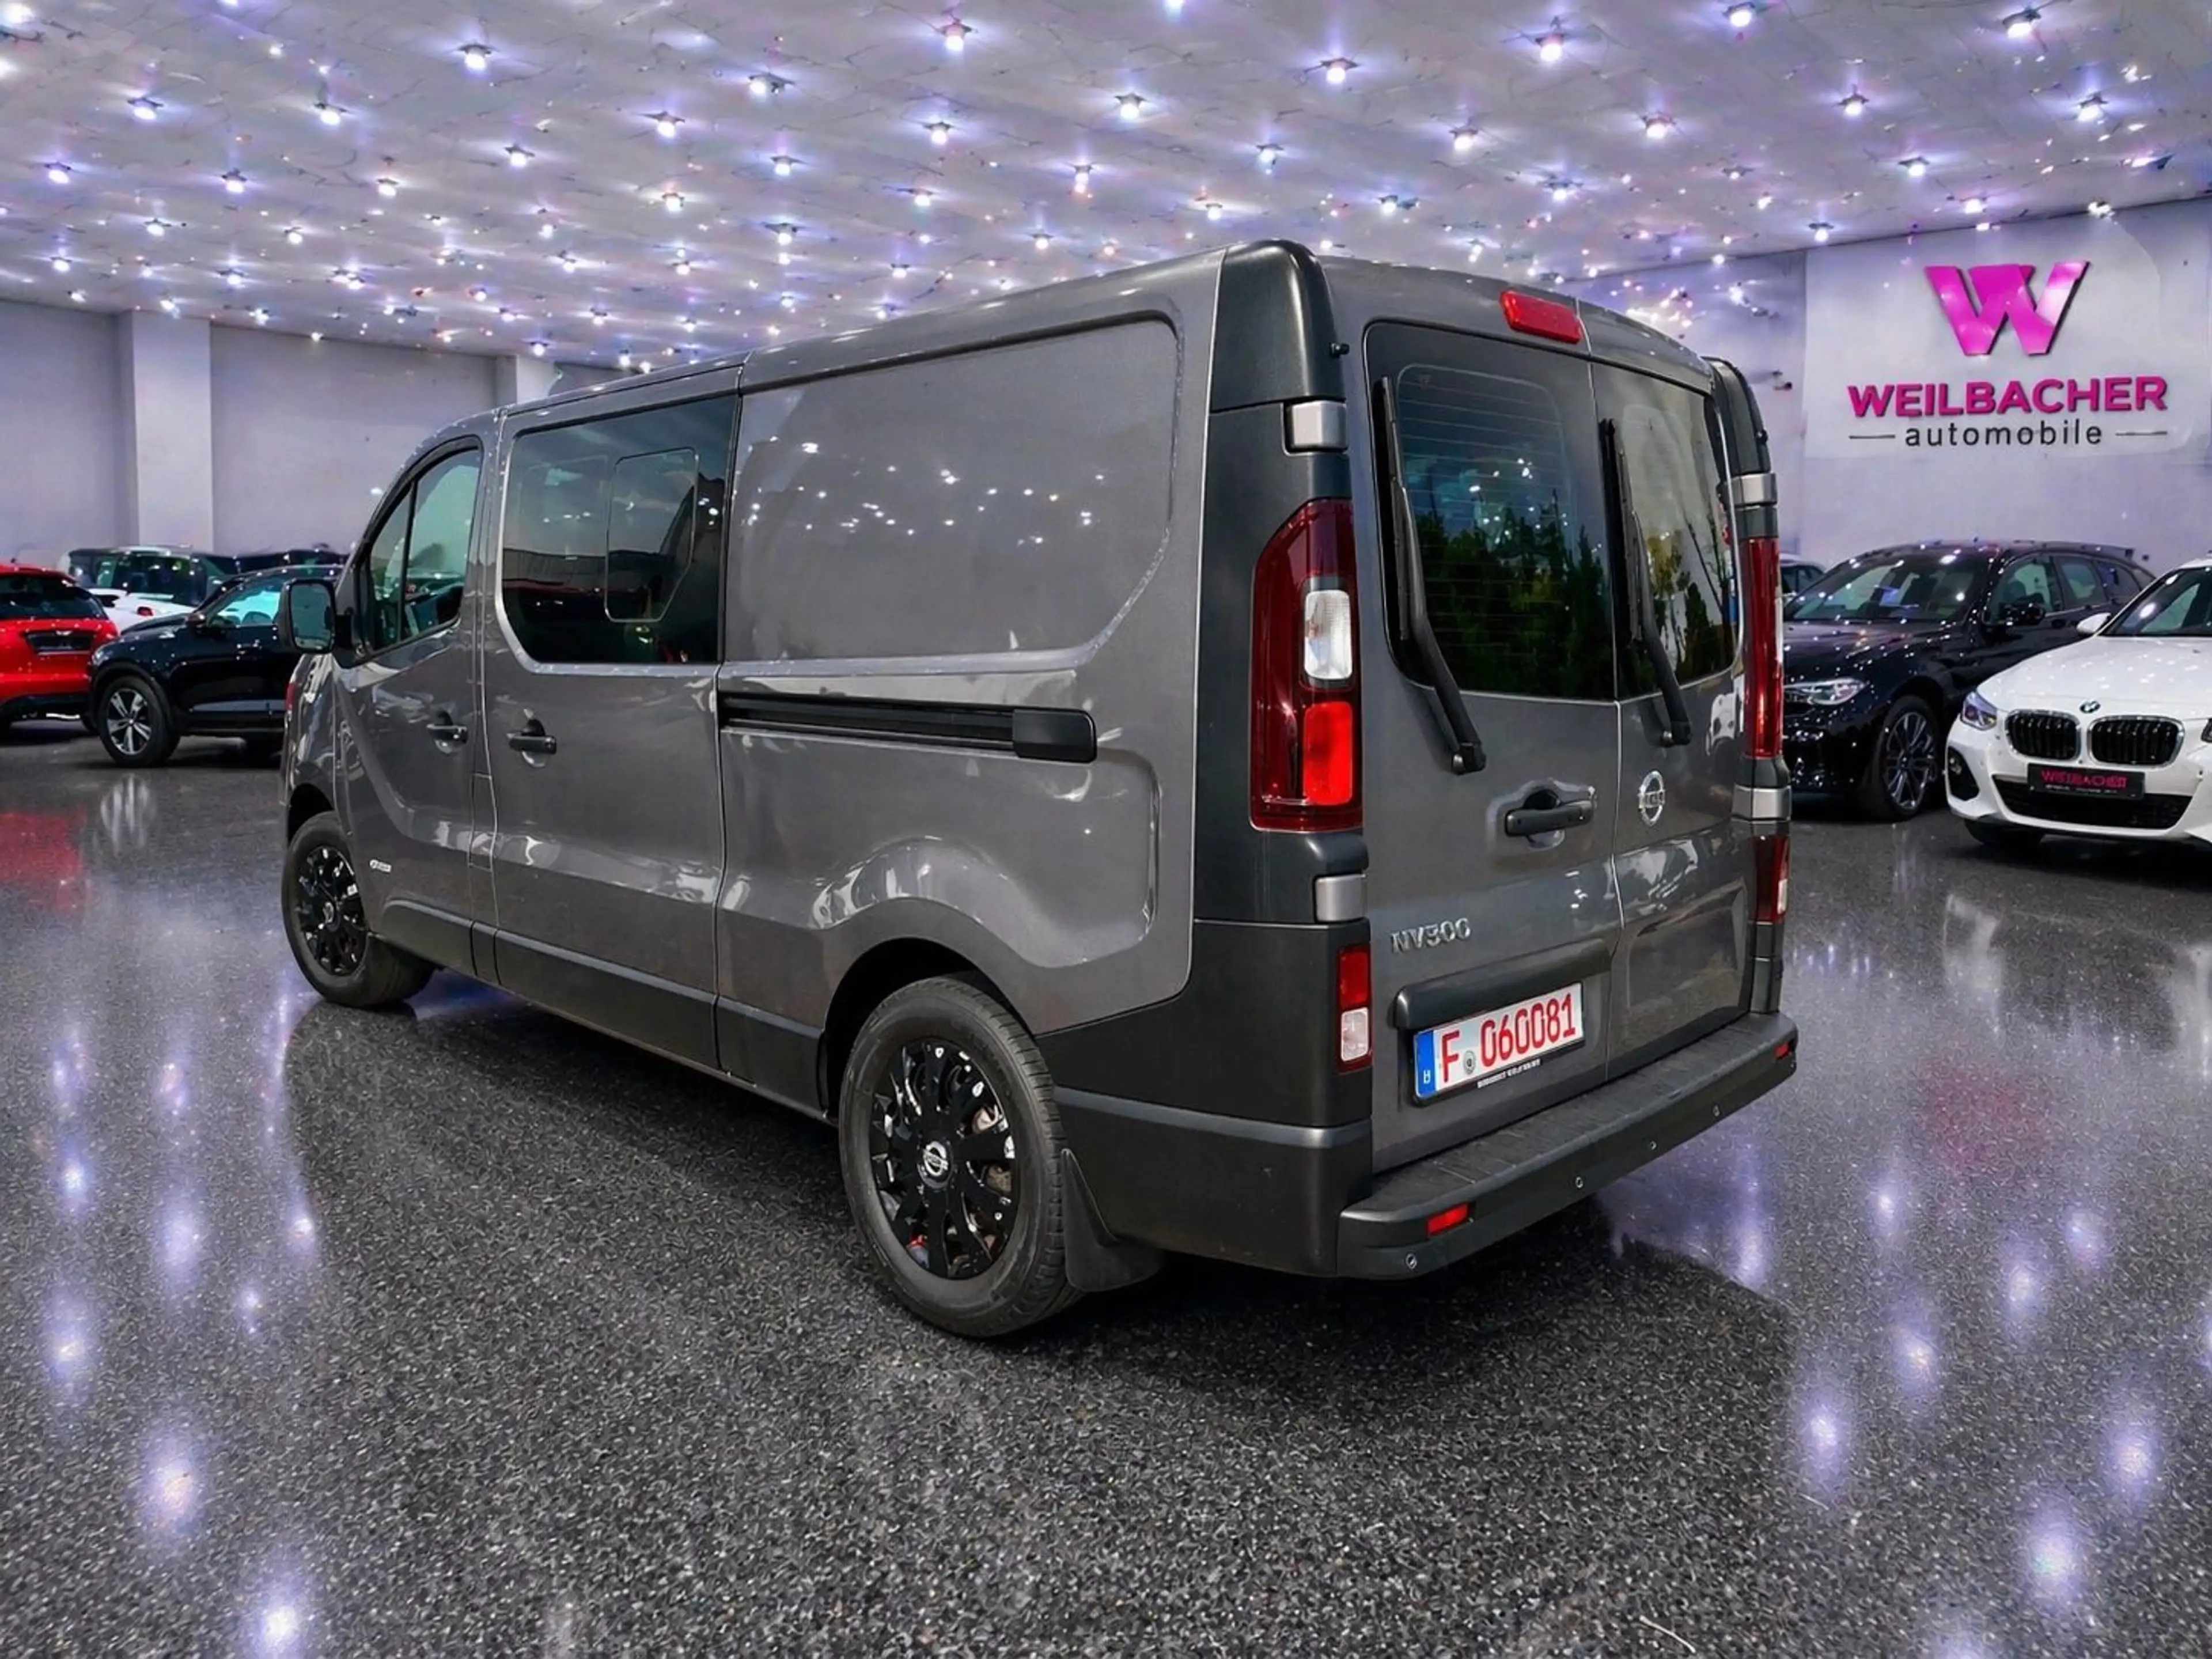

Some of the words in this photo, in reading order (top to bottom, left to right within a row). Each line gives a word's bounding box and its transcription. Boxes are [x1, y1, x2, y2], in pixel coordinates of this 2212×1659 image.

[1847, 376, 2168, 417] WEILBACHER
[1904, 419, 2103, 446] automobile
[1391, 918, 1471, 954] NV300
[1442, 1029, 1460, 1083] F
[1480, 993, 1576, 1067] 060081
